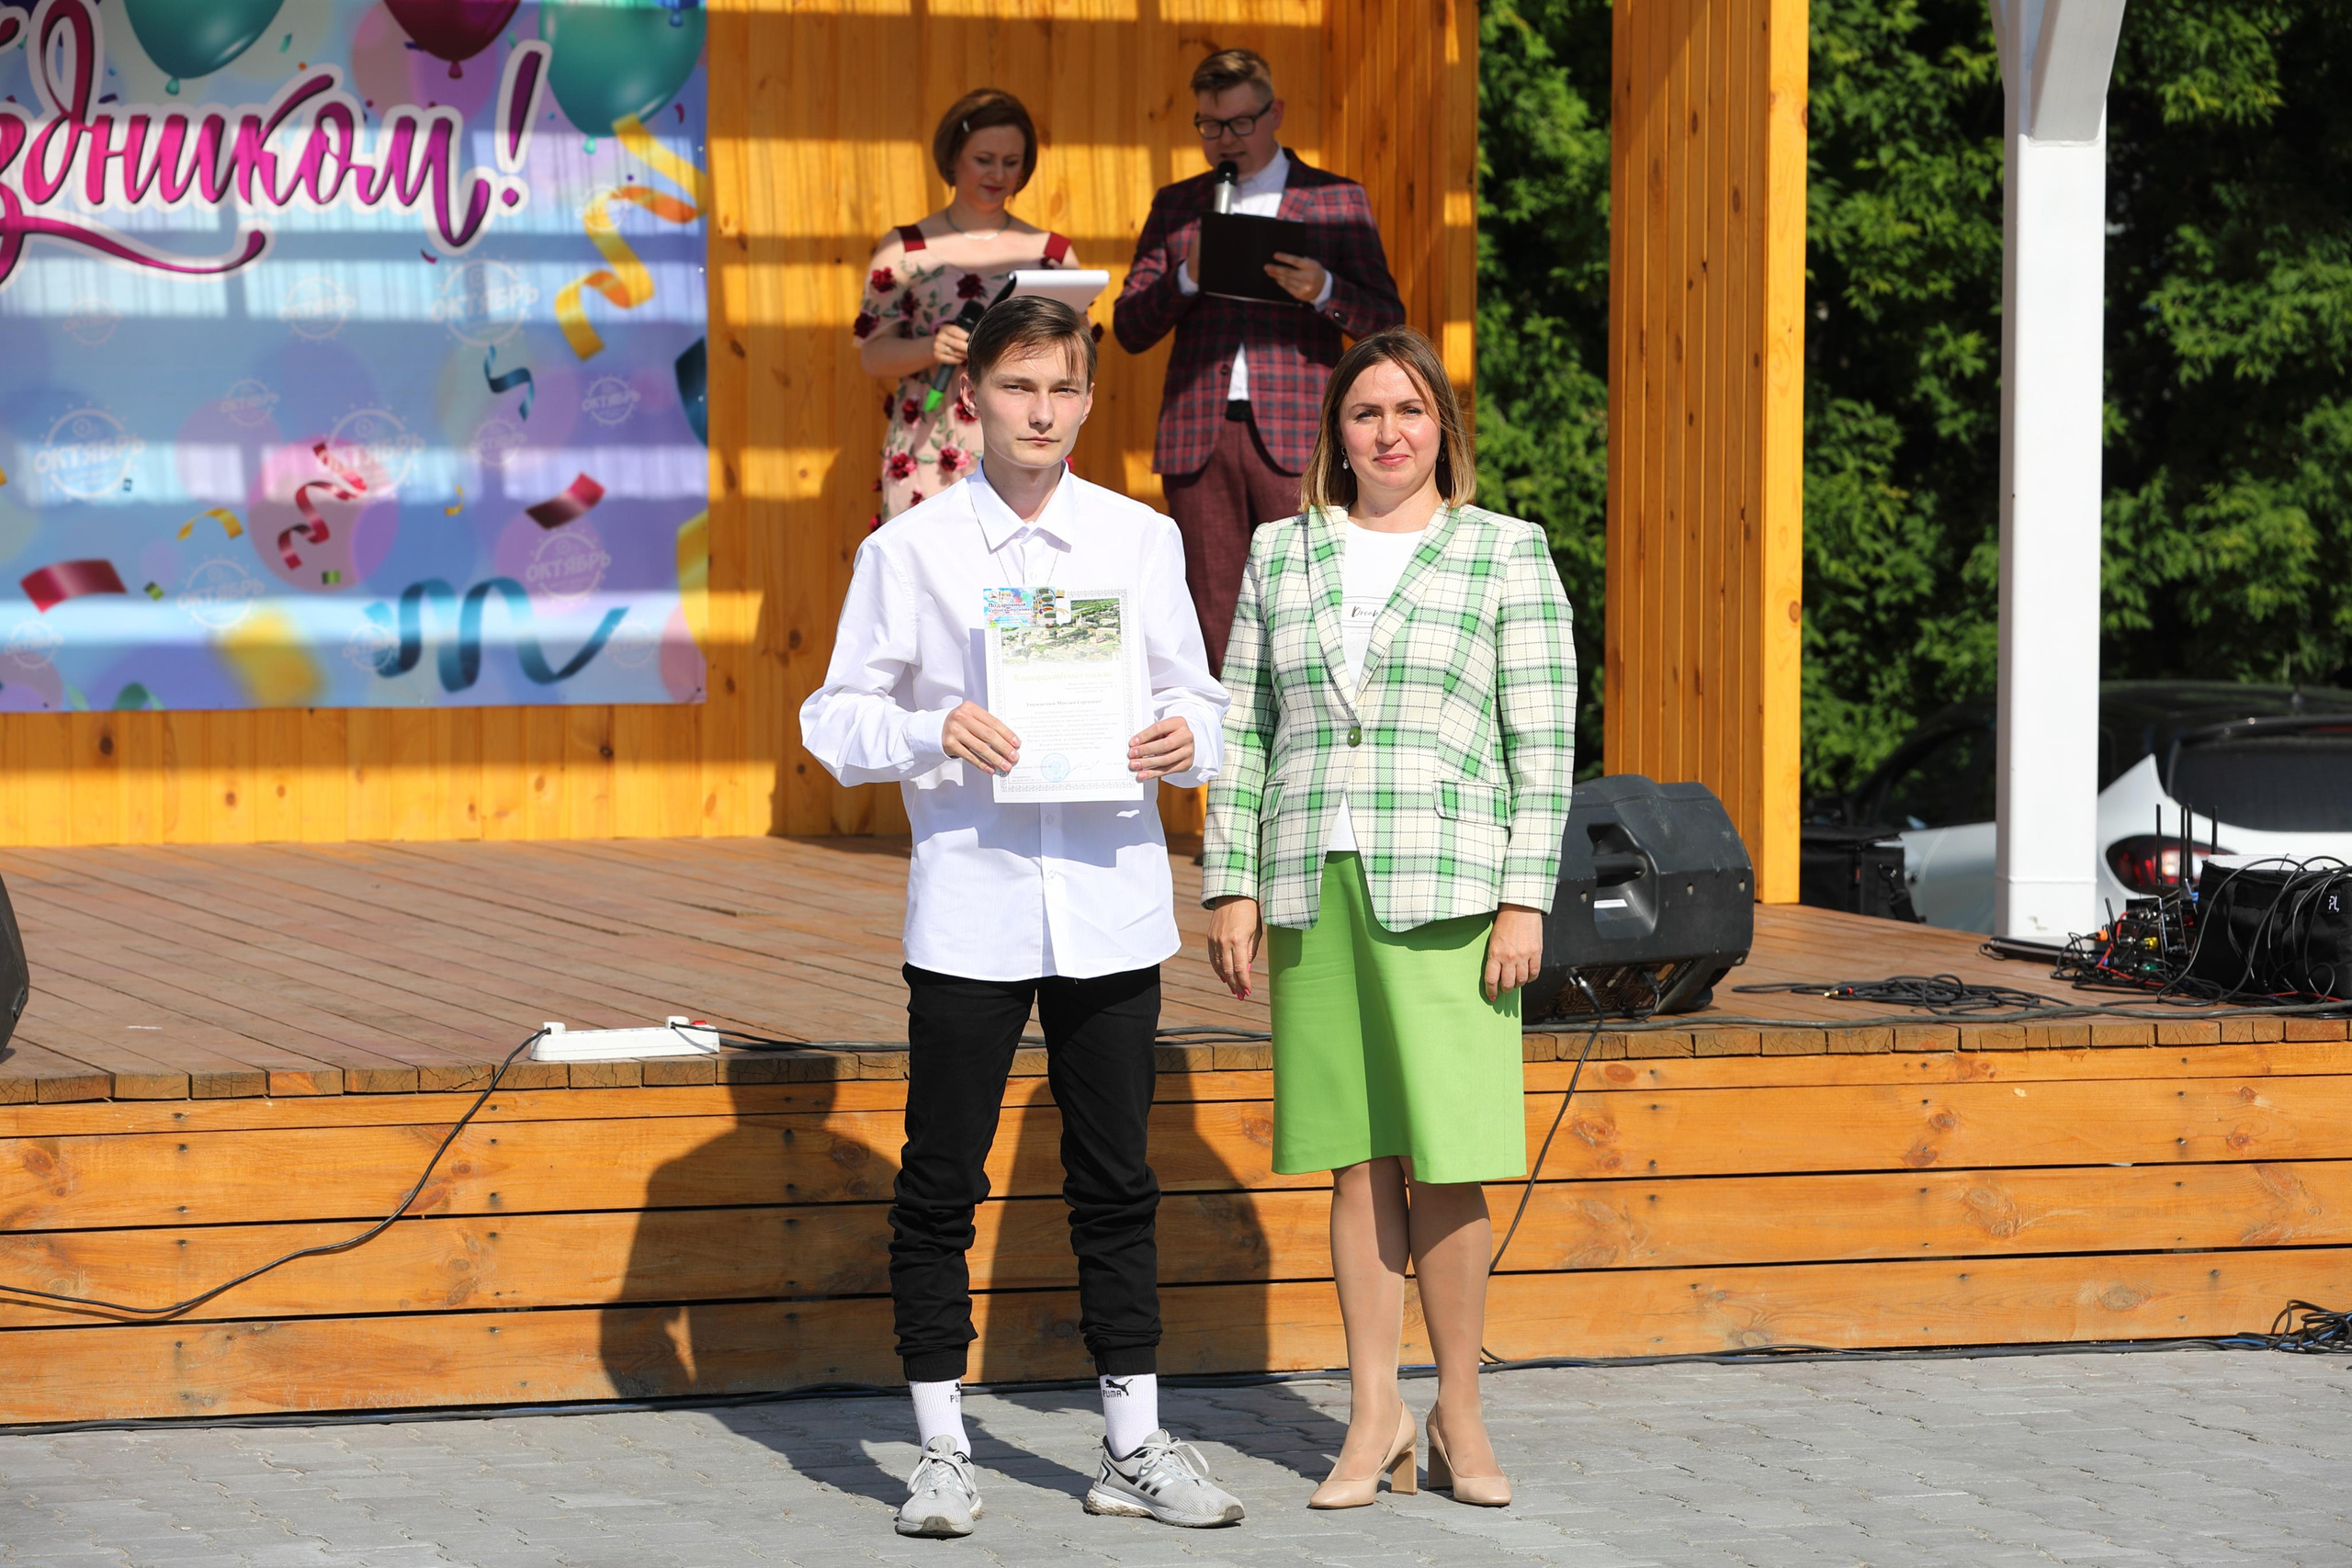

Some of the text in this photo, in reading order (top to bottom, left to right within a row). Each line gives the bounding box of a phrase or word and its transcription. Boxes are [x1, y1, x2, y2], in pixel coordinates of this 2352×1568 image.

[429, 280, 540, 323] ОКТЯБРЬ
[33, 431, 147, 474] ОКТЯБРЬ
[526, 549, 613, 583] ОКТЯБРЬ
[1102, 1389, 1122, 1398] PUMA
